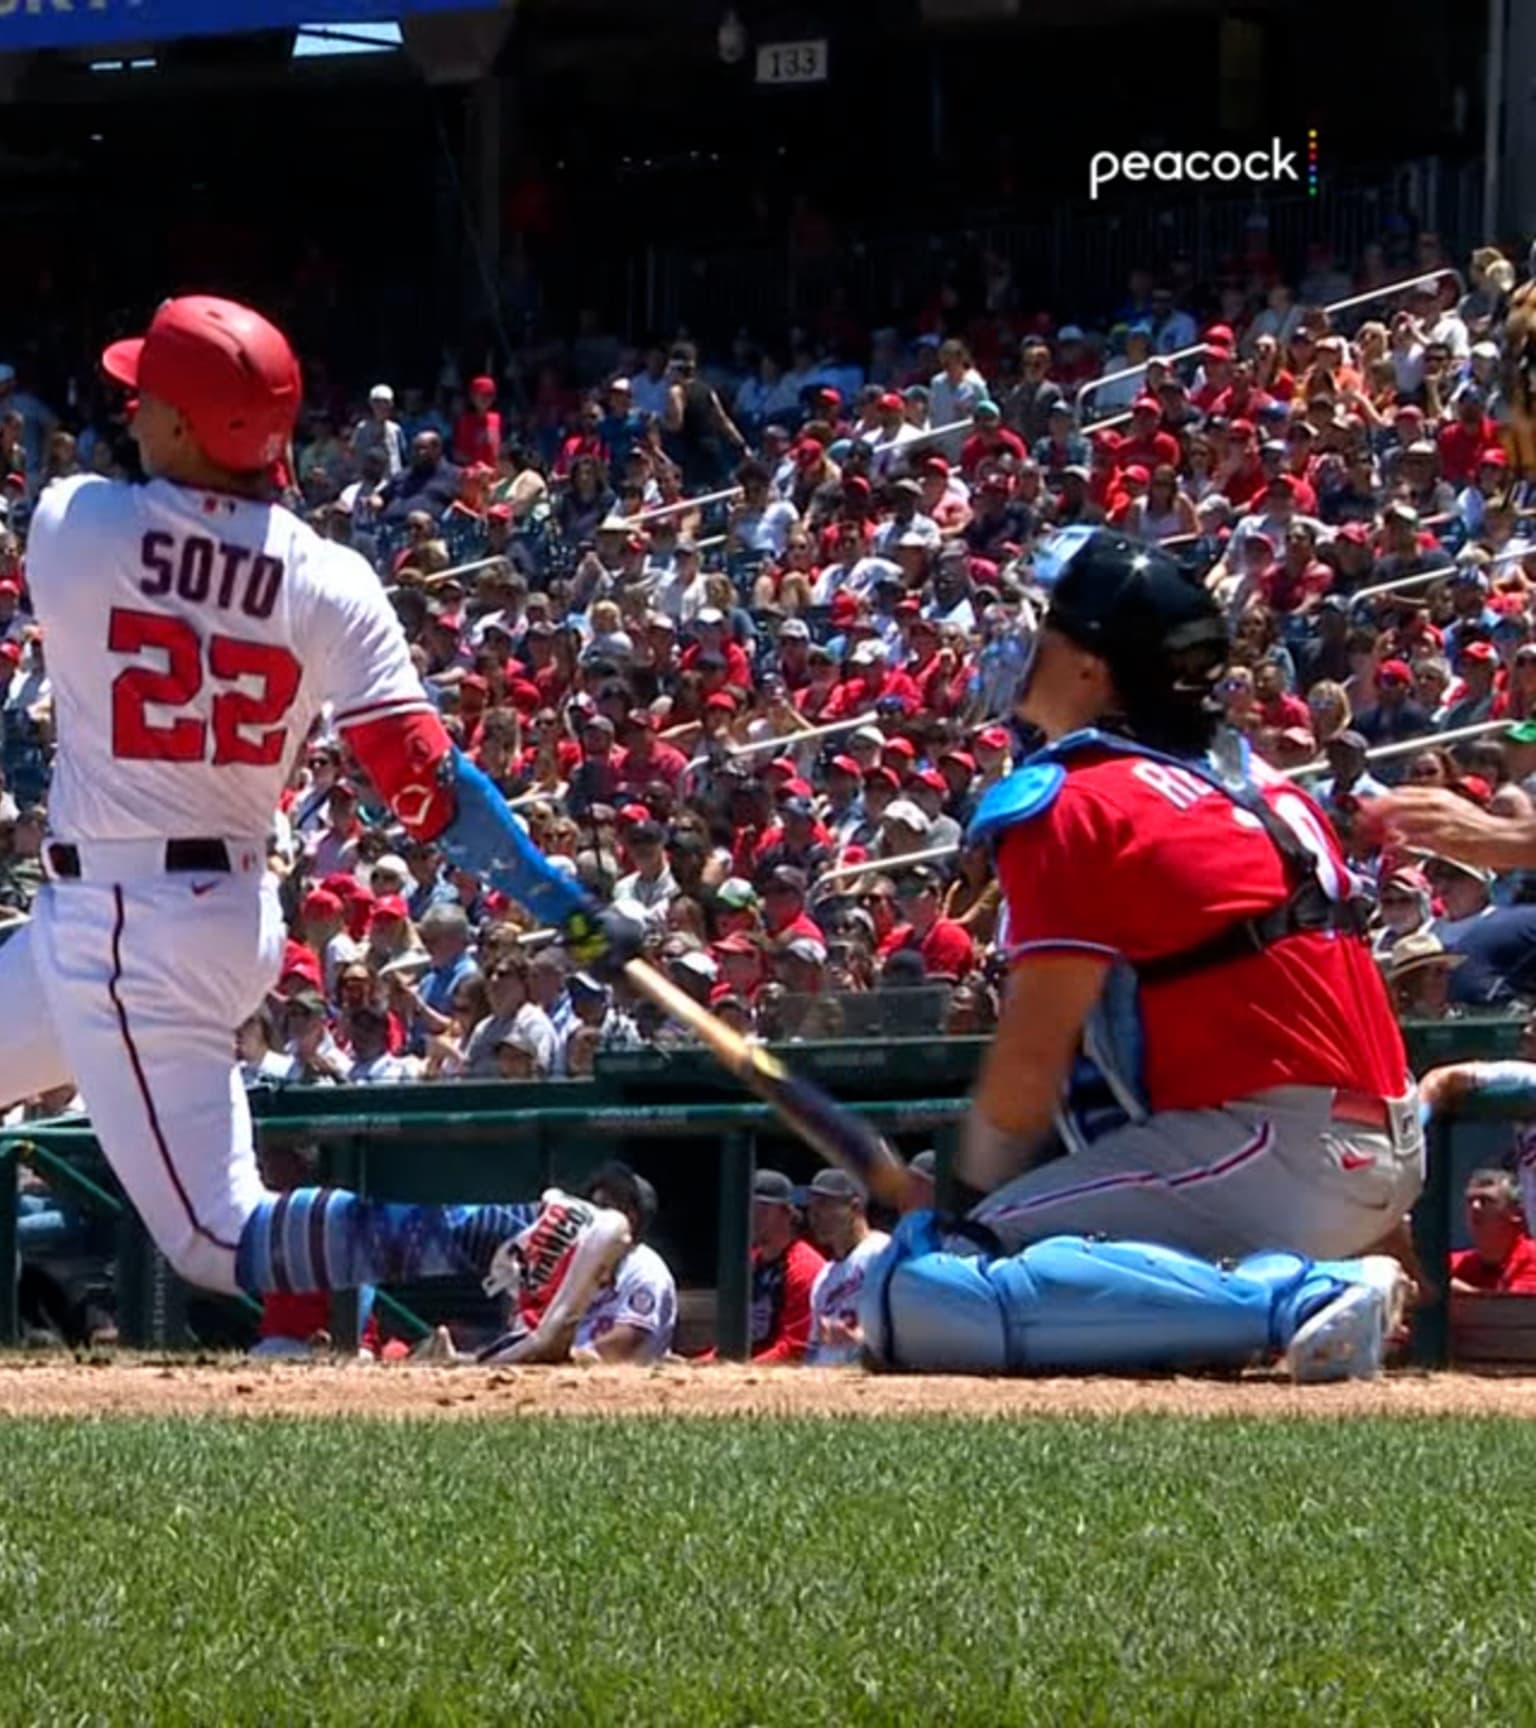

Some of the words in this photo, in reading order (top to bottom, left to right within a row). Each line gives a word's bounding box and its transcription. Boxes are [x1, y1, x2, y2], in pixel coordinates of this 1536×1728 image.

[770, 47, 816, 77] 133
[140, 529, 284, 618] SOTO
[107, 606, 302, 767] 22
